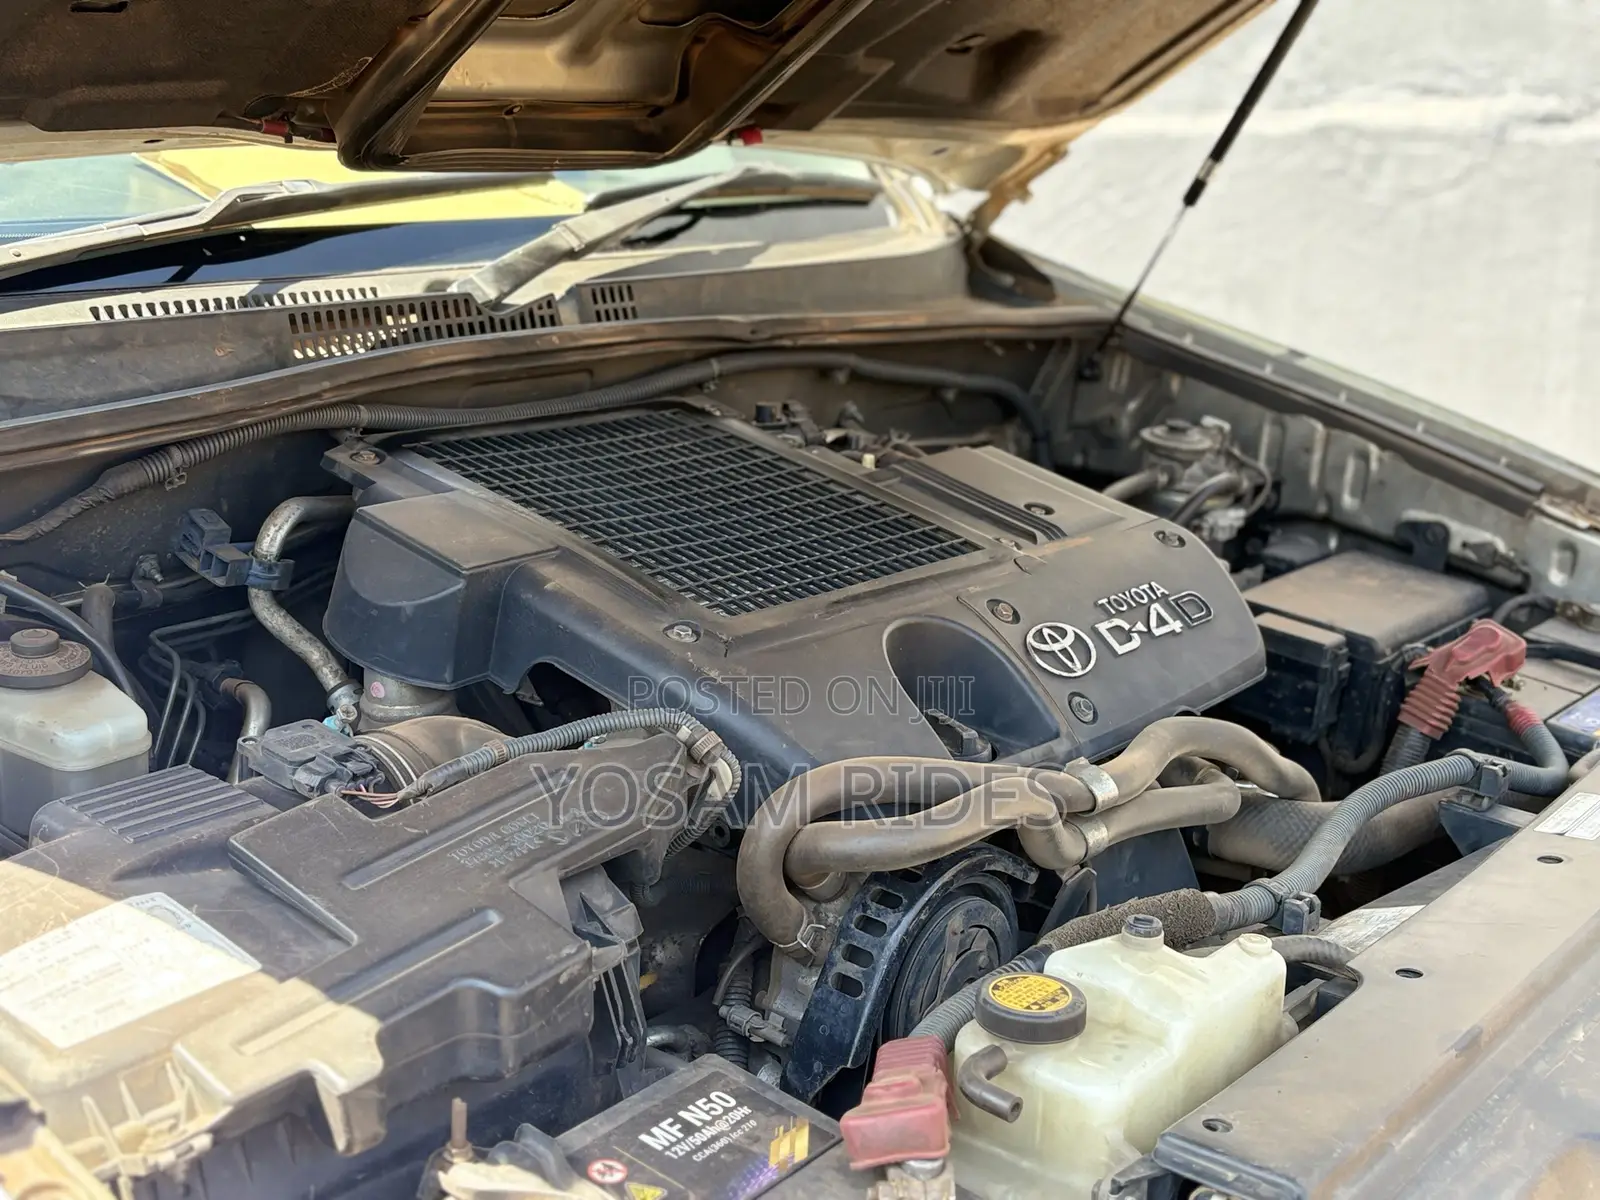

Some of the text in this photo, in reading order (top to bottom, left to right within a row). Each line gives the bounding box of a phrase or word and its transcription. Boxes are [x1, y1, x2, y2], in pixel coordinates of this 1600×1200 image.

[1097, 581, 1169, 615] TOYOTA
[638, 1091, 737, 1151] MF N50
[664, 1105, 752, 1159] 12V/50Ah@20Hr
